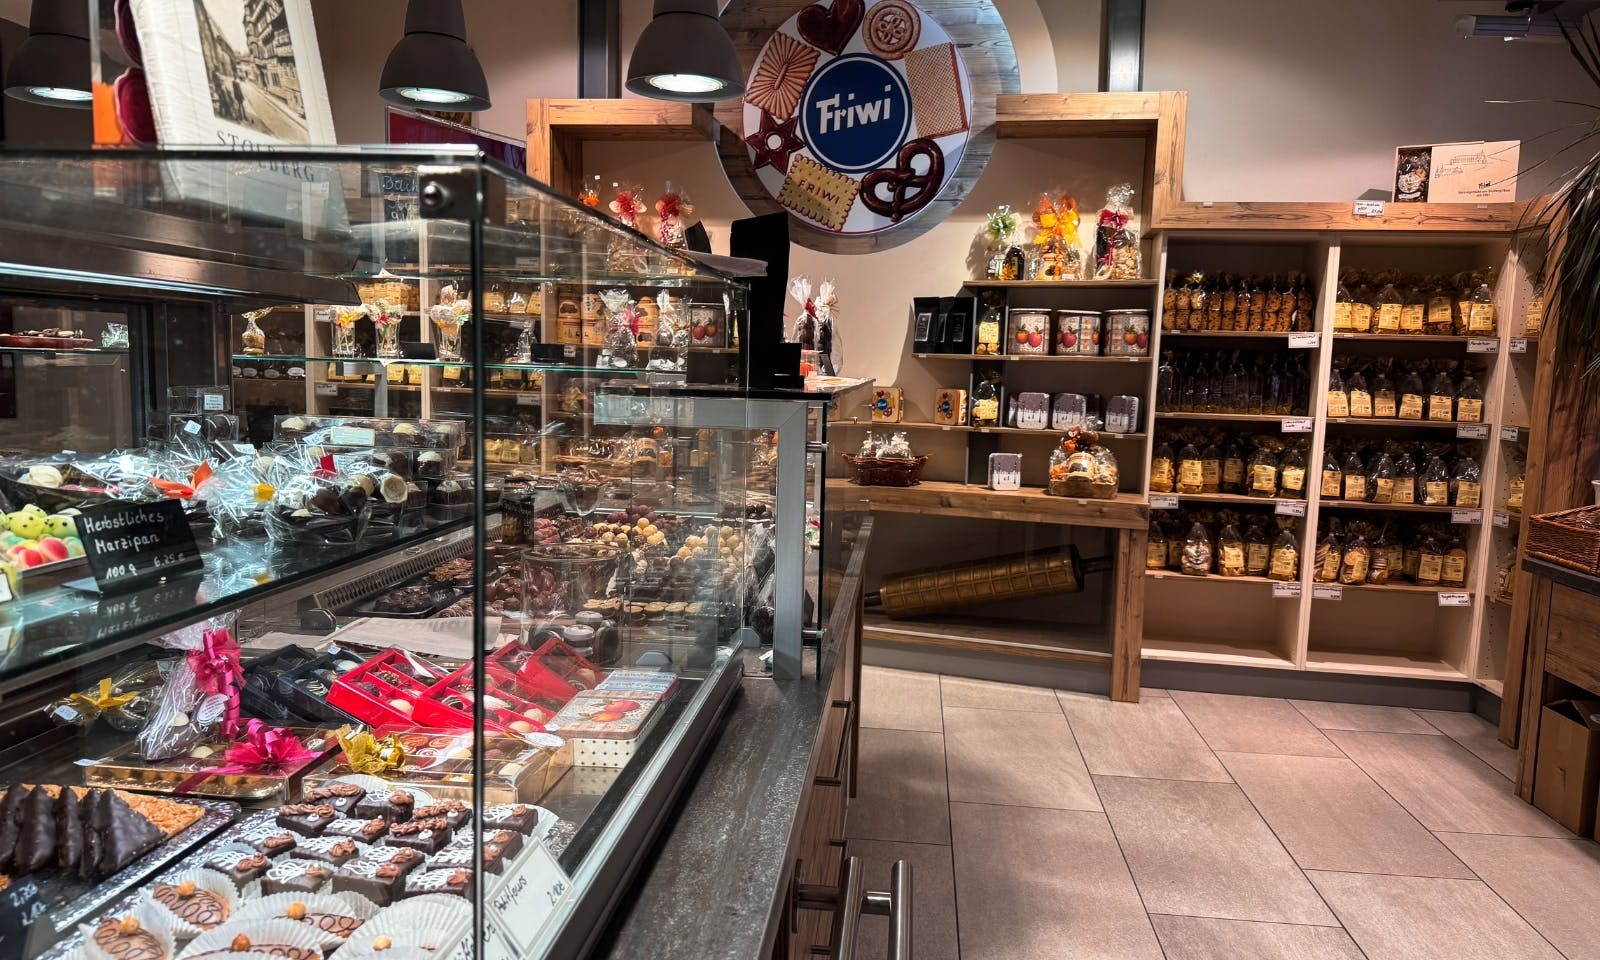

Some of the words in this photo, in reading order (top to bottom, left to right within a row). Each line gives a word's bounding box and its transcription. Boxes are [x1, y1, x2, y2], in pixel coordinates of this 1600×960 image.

[816, 84, 892, 134] Friwi
[798, 179, 840, 205] FRIWI
[84, 507, 165, 534] Herbstliches
[95, 534, 160, 554] Marzipan
[106, 566, 126, 580] 100
